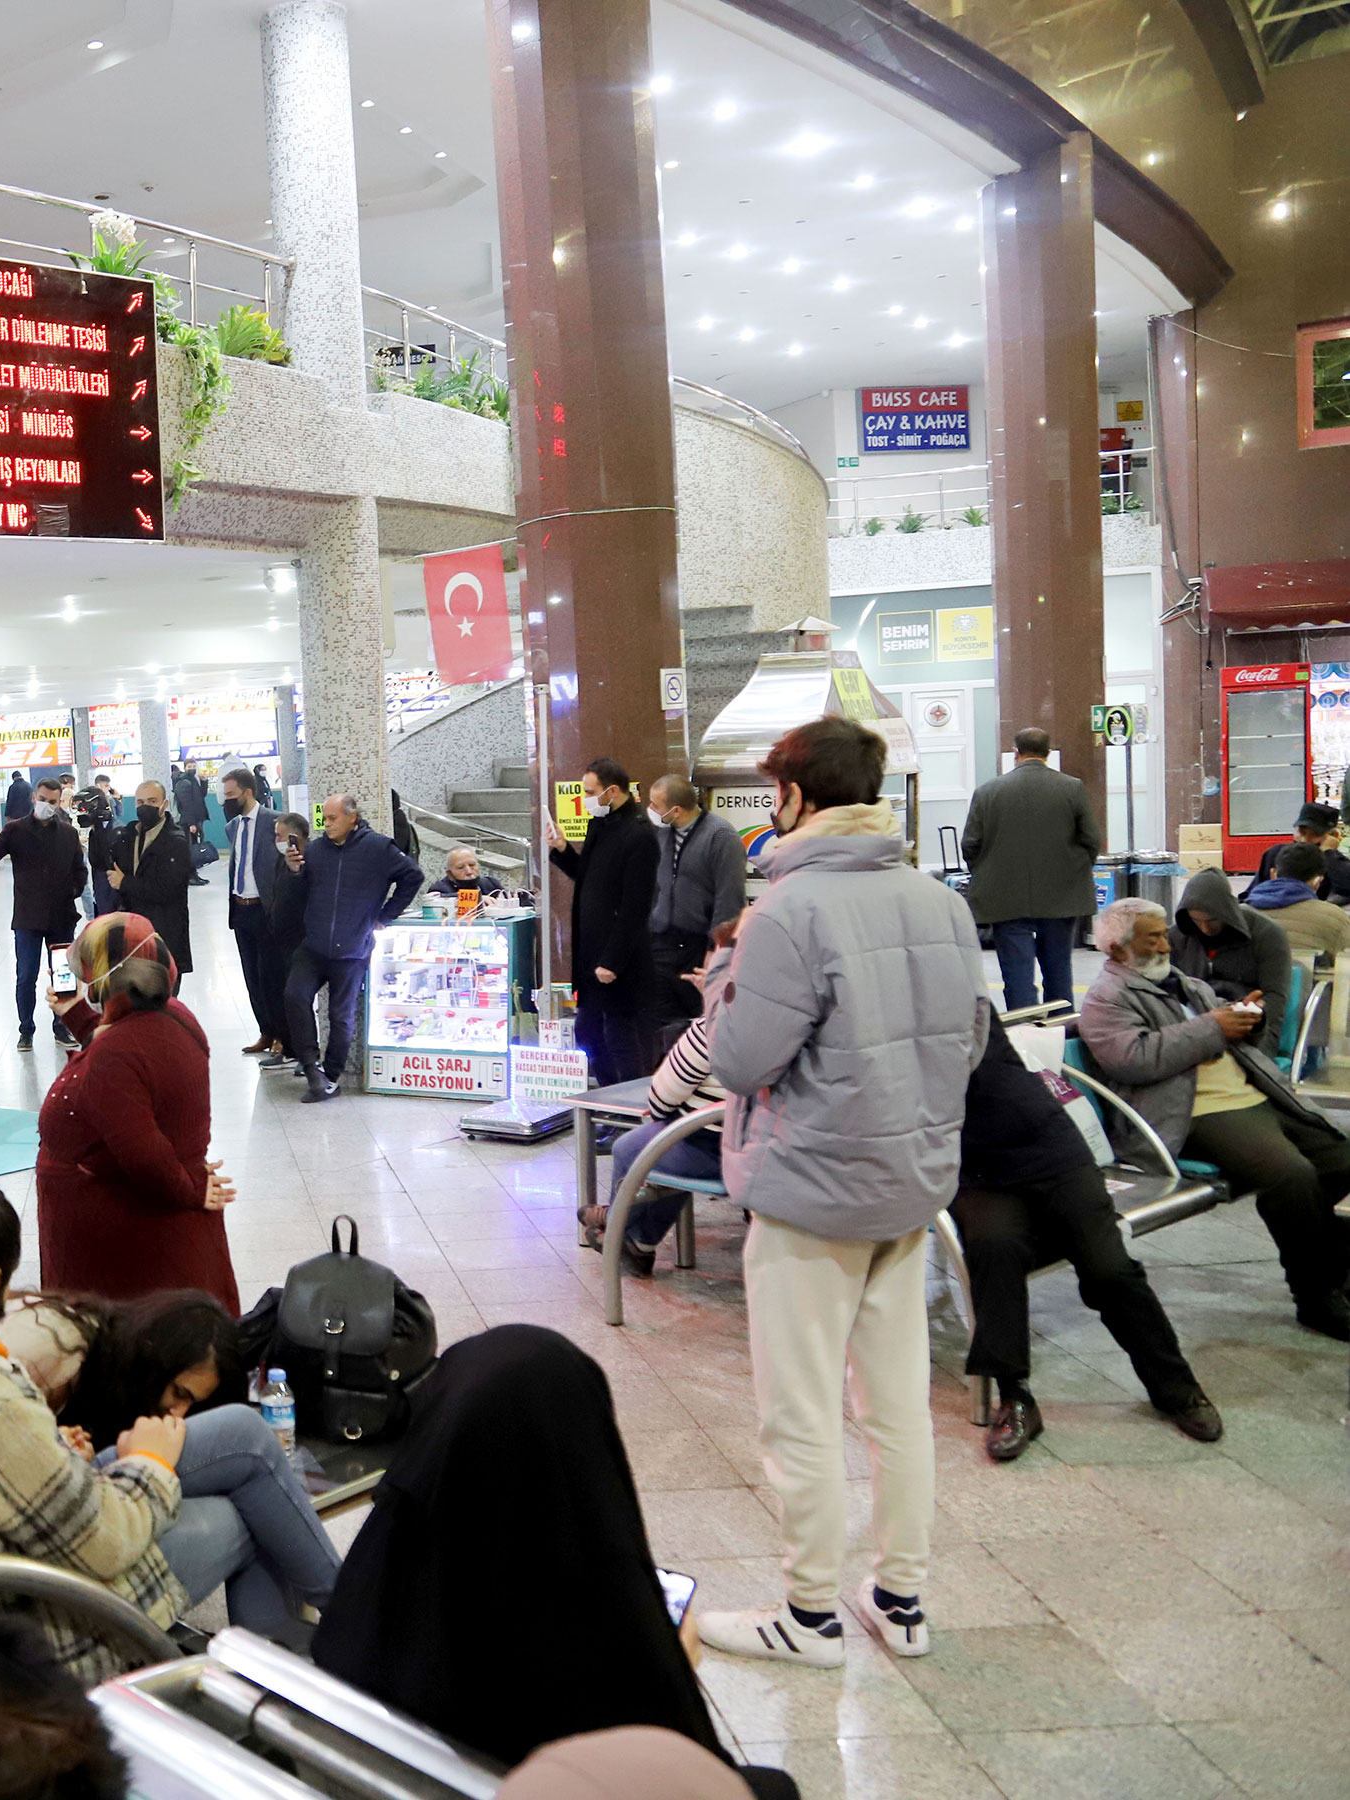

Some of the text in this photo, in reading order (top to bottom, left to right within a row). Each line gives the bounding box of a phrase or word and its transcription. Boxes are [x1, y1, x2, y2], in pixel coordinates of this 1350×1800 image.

[11, 314, 70, 347] DİNLENME
[71, 322, 107, 352] TESİSİ
[18, 361, 110, 397] MÜDÜRLÜKLERİ
[871, 391, 958, 407] BUSS CAFE
[22, 407, 74, 438] MİNİBÜS
[865, 414, 967, 435] ÇAY & KAHVE
[866, 435, 889, 447] TOST
[896, 433, 922, 447] SİMİT
[930, 432, 966, 447] POĞAÇA
[15, 457, 81, 484] REYONLARI
[6, 503, 28, 527] WC
[881, 624, 929, 639] BENİM
[882, 638, 929, 653] ŞEHRİM
[1235, 667, 1281, 682] Coca-Cola
[402, 1056, 471, 1075] ACİL ŞARJ
[400, 1073, 473, 1091] İSTASYONU
